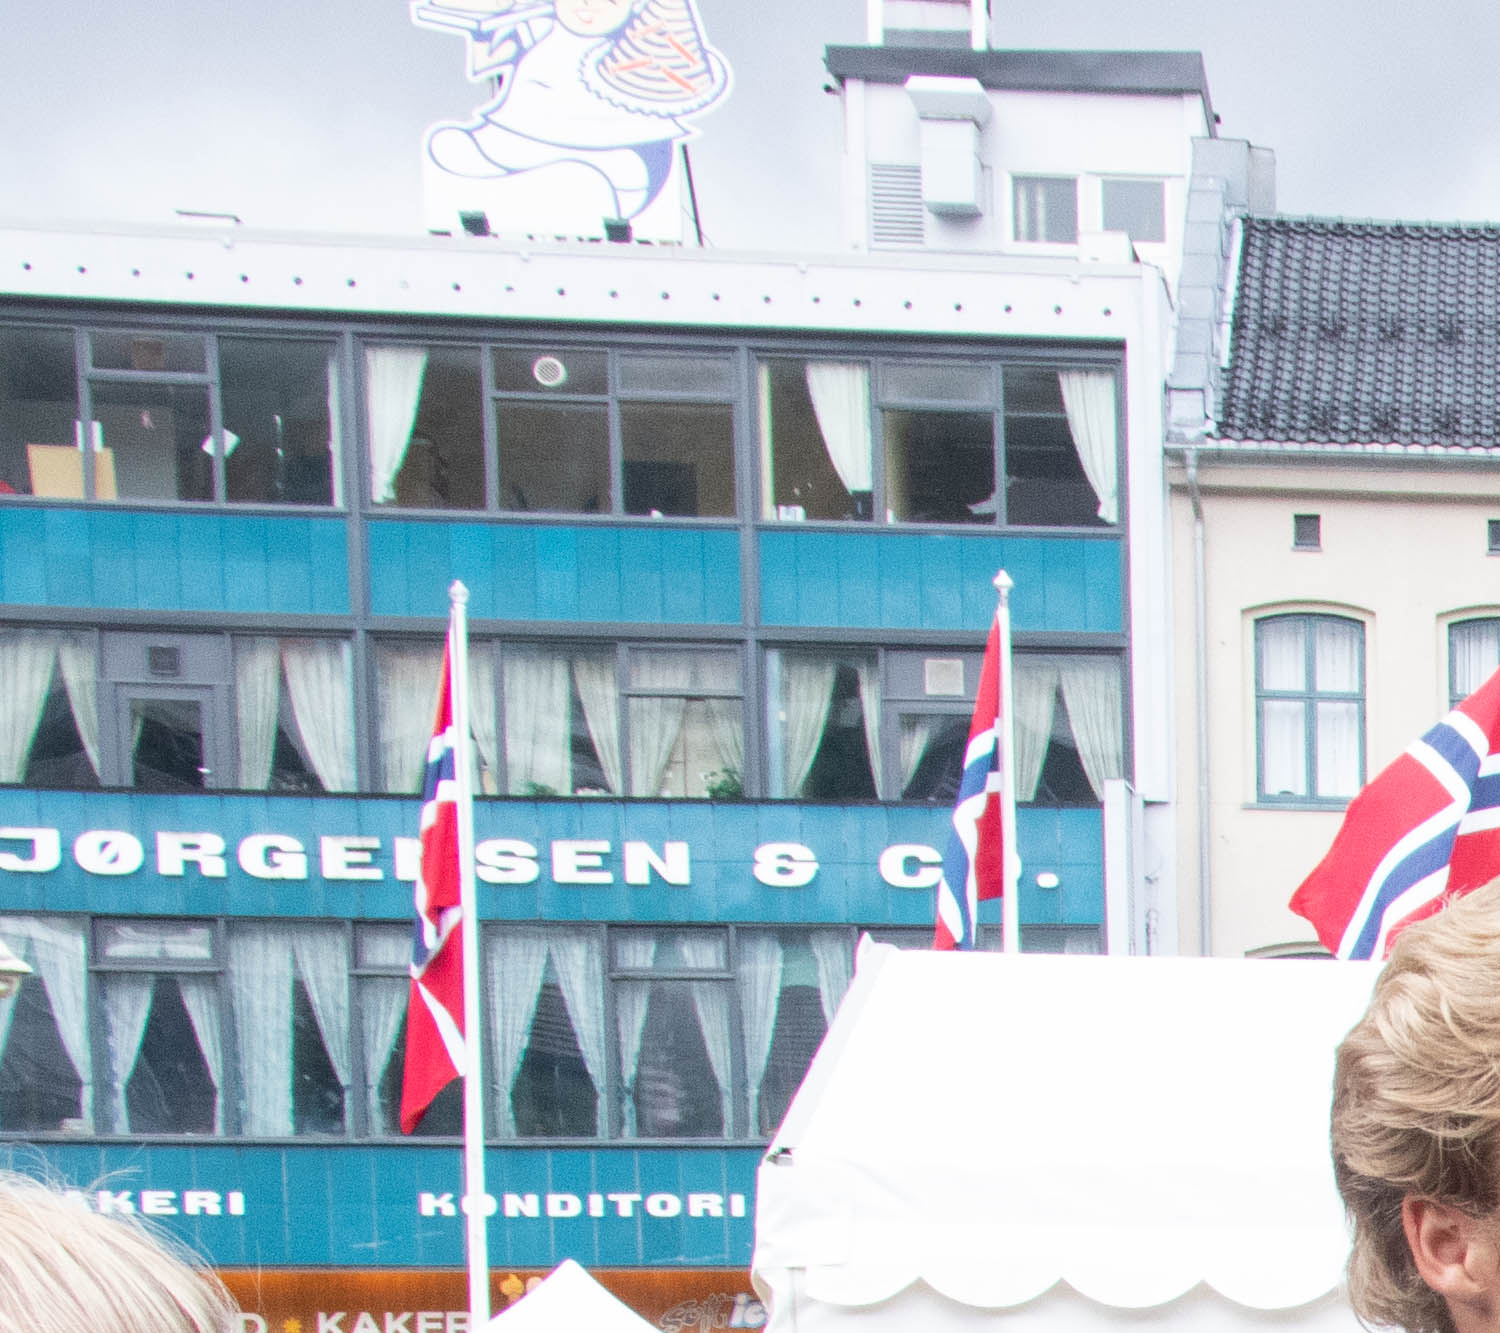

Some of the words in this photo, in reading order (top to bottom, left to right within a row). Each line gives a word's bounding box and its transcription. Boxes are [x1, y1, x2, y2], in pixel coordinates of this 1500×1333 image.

[752, 842, 819, 889] &
[879, 843, 1060, 889] C.
[417, 1191, 746, 1217] KONDITORI
